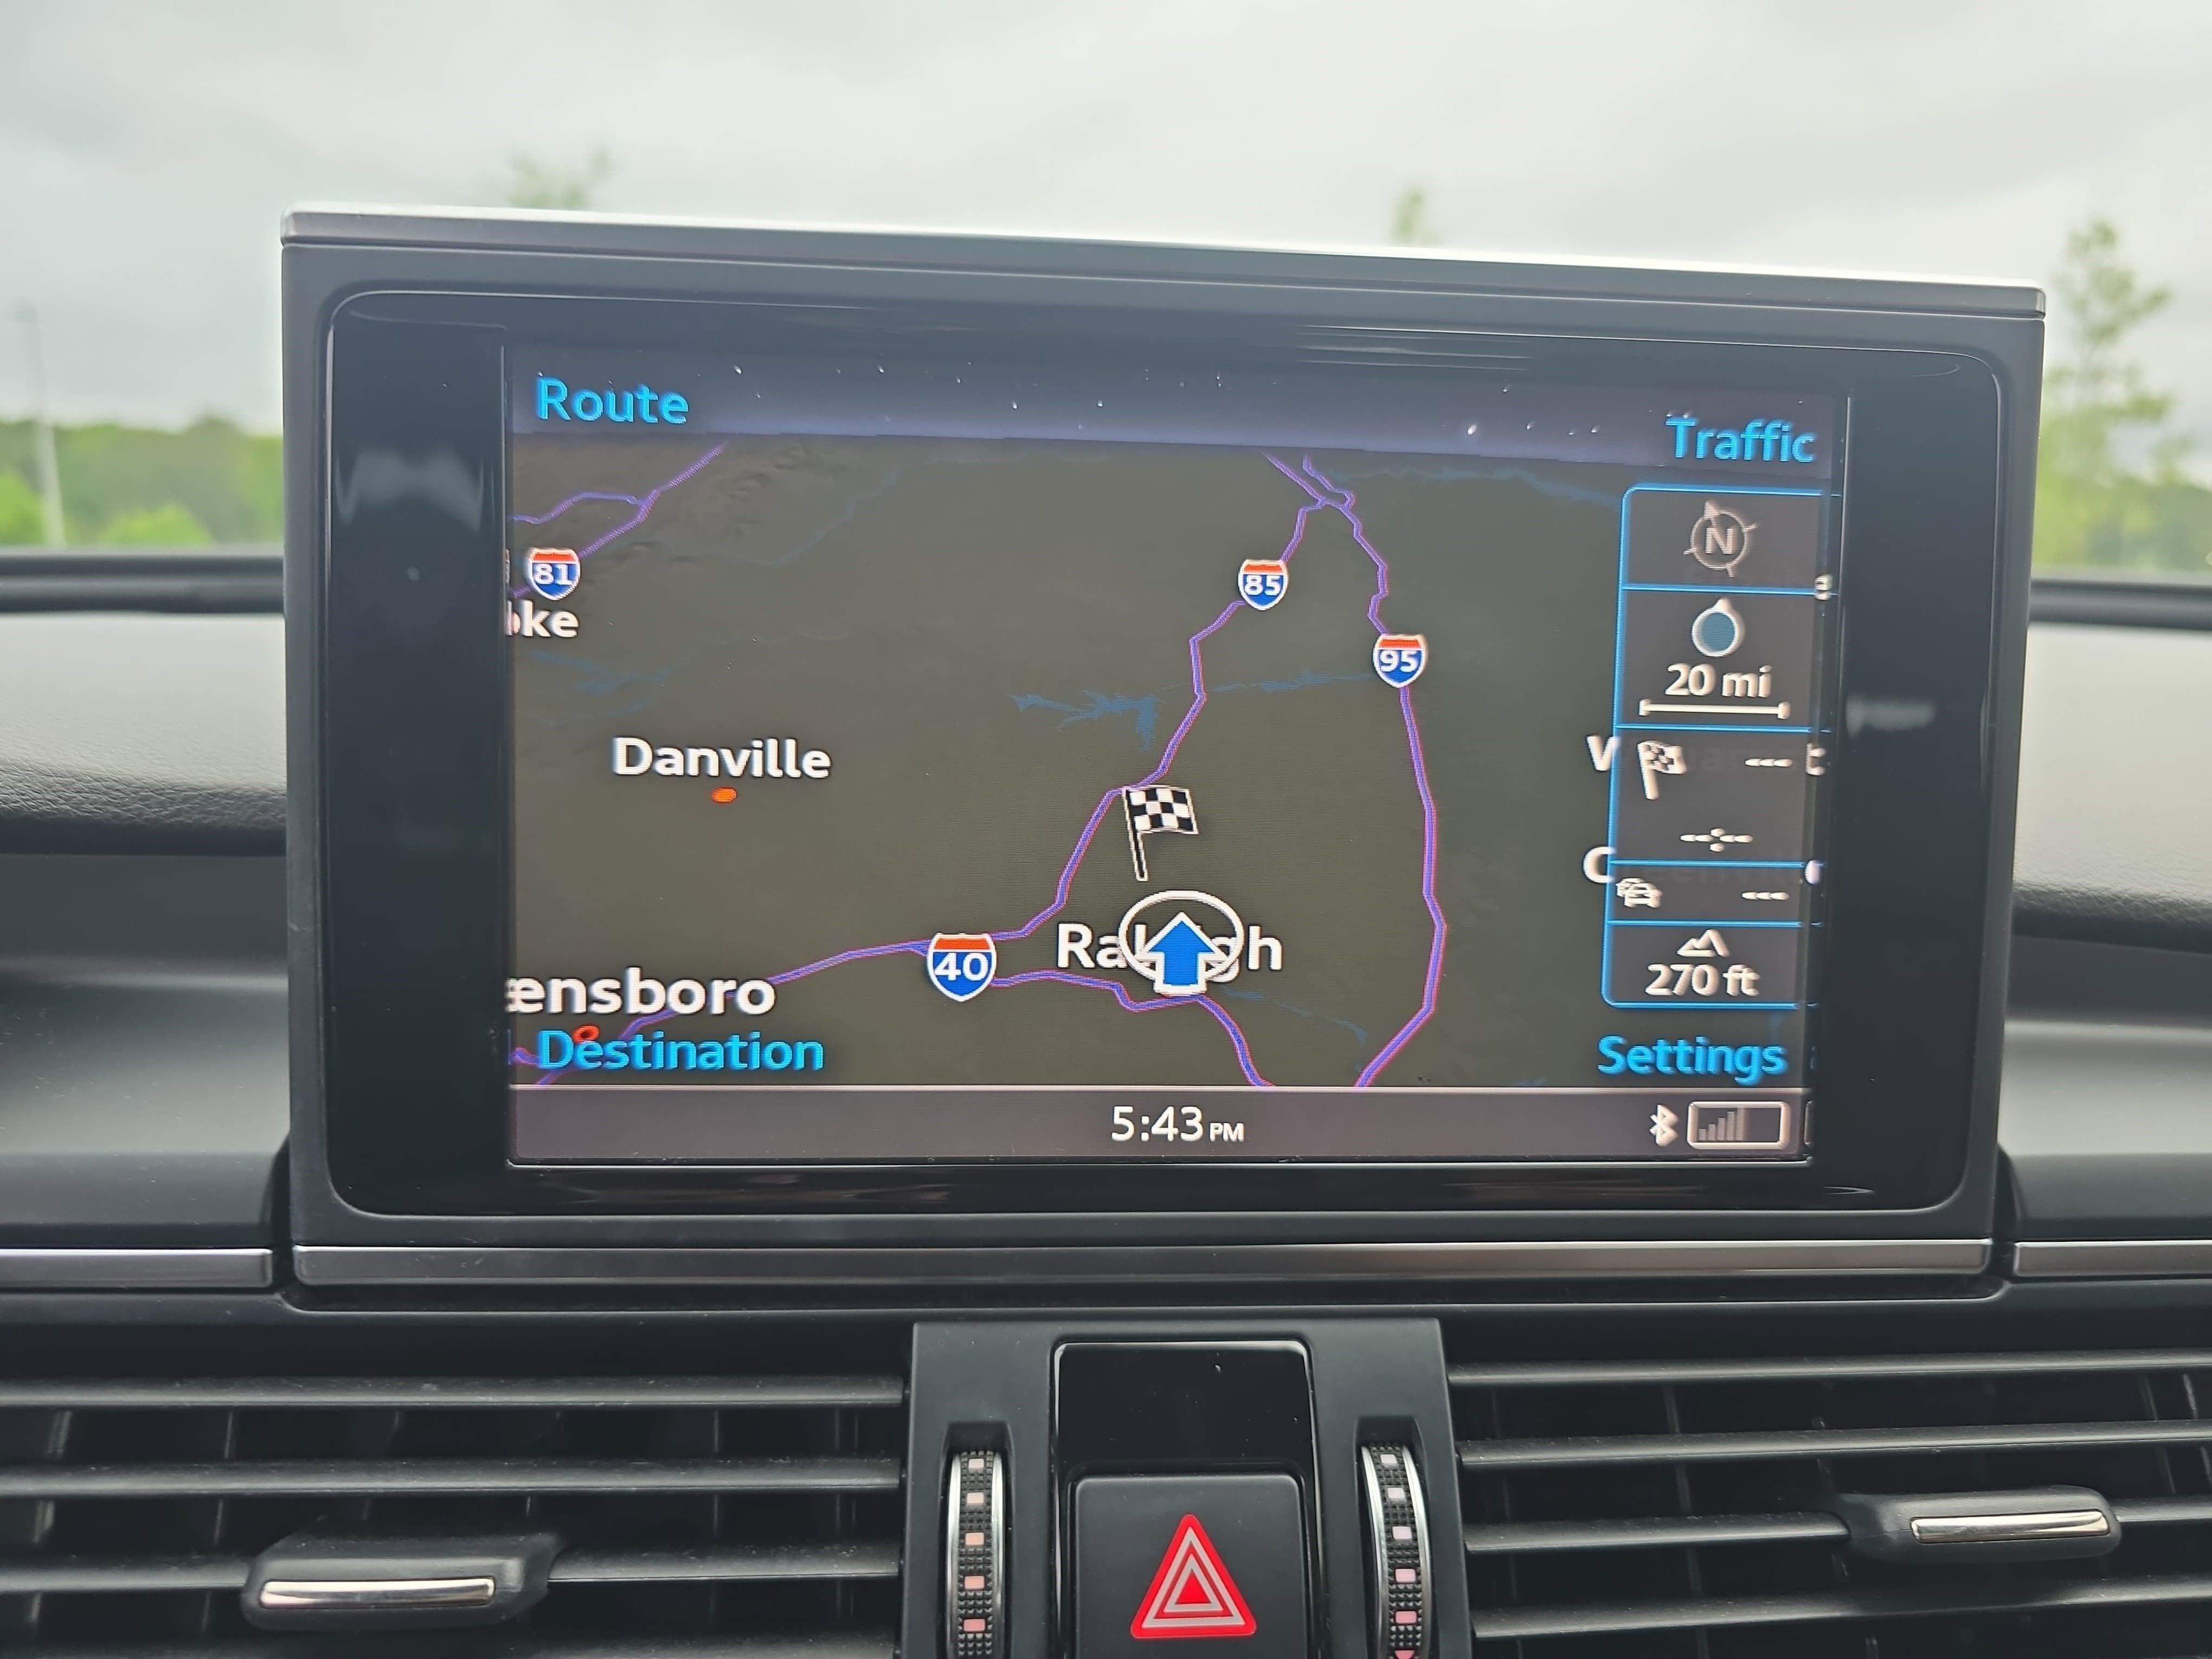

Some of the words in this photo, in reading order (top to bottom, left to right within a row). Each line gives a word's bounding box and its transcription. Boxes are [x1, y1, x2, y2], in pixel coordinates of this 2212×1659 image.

[536, 376, 690, 425] Route
[1666, 416, 1816, 463] Traffic
[532, 563, 573, 586] 81
[1244, 574, 1283, 596] 85
[1379, 650, 1419, 673] 95
[1666, 663, 1714, 697] 20
[1721, 666, 1772, 698] mi
[613, 736, 832, 780] Danville
[934, 953, 989, 981] 40
[1645, 963, 1719, 996] 270
[1722, 963, 1761, 996] ft
[537, 1030, 824, 1071] Destination
[1597, 1036, 1787, 1085] Settings
[1110, 1105, 1204, 1143] 5:43
[1209, 1124, 1245, 1143] PM
